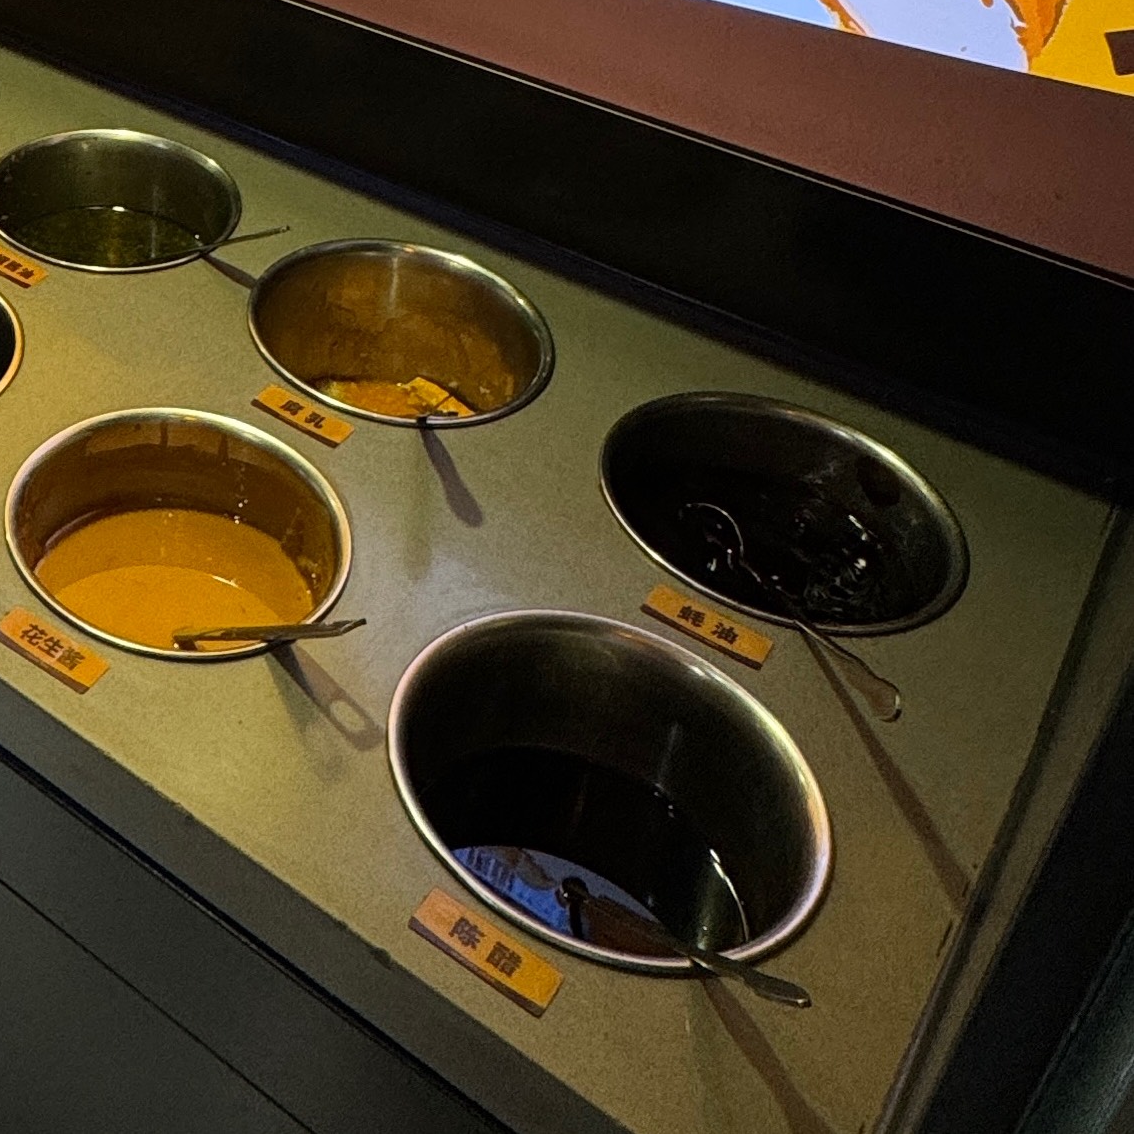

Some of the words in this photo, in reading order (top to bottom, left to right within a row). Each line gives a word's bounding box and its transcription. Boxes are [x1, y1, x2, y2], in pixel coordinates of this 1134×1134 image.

[19, 623, 86, 671] 花生酱
[447, 915, 523, 979] 陈醋
